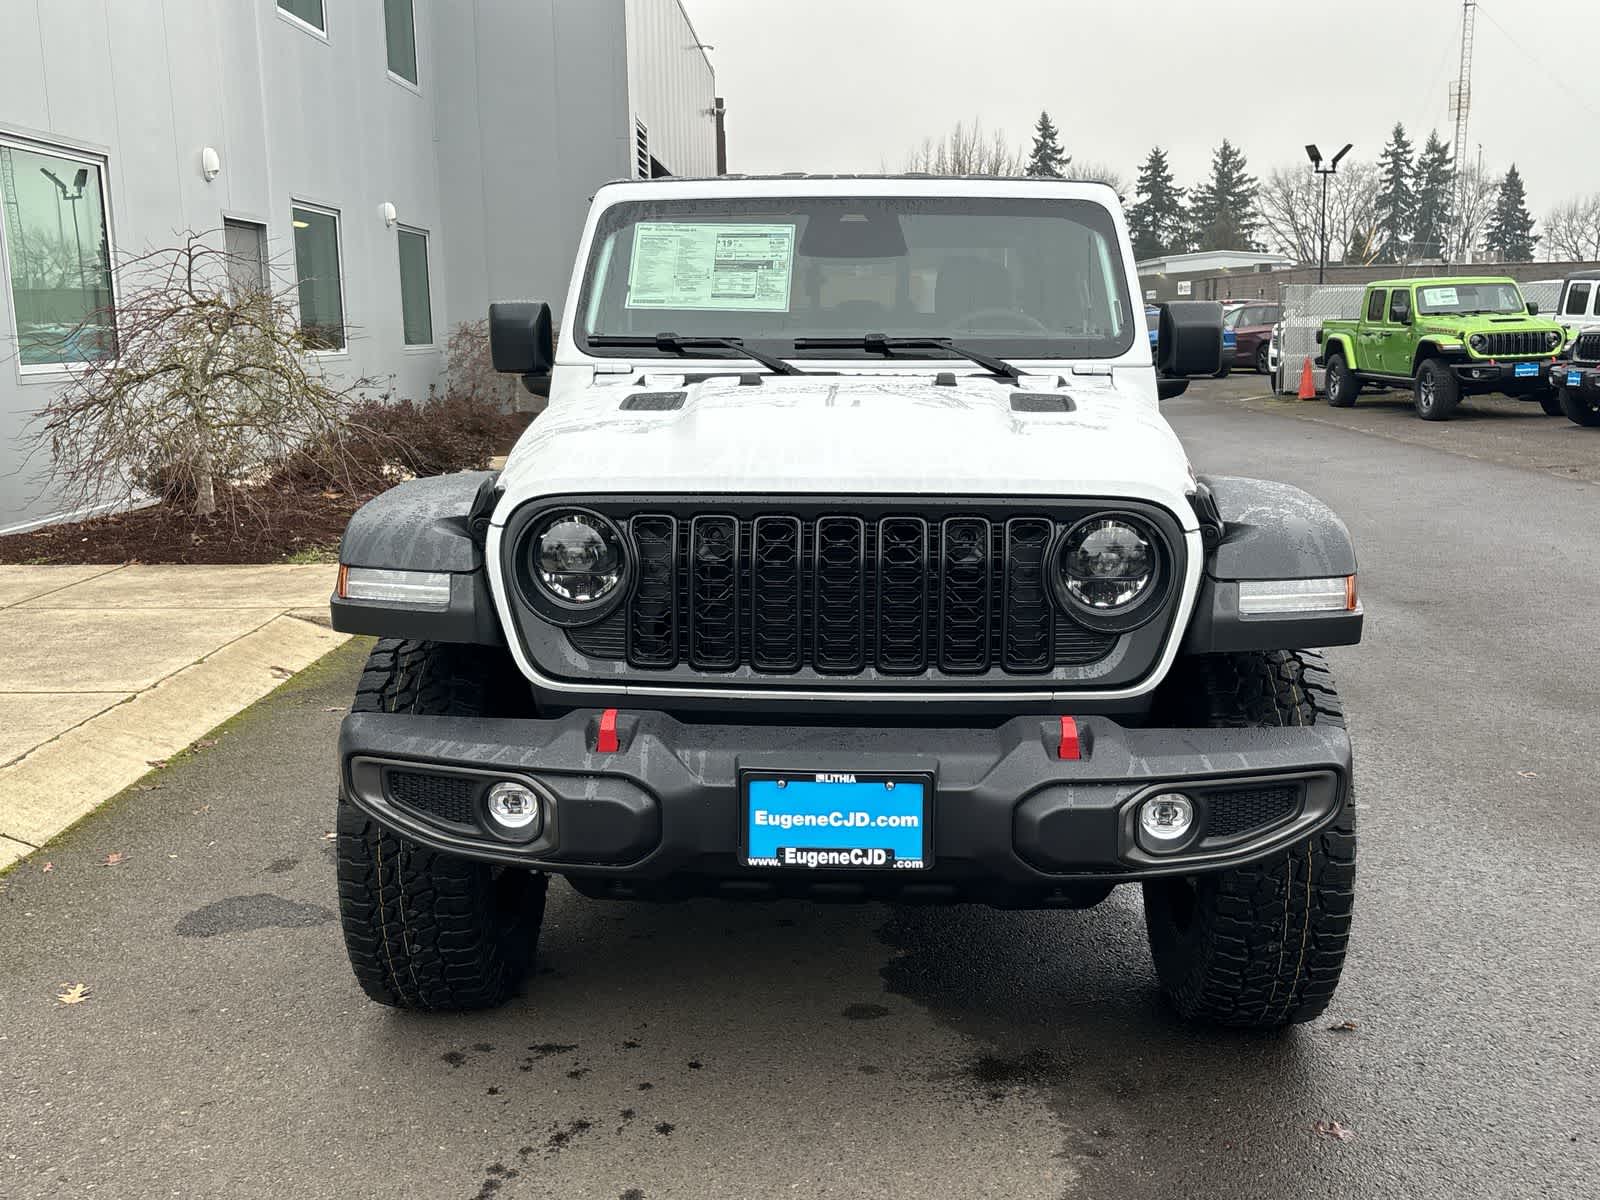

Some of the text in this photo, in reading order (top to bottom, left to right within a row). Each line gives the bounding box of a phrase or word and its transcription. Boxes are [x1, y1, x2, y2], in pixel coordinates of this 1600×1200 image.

[825, 774, 856, 783] LITHIA
[754, 809, 918, 828] EugeneCJD.com
[747, 848, 924, 868] www. EugeneCJD .com
